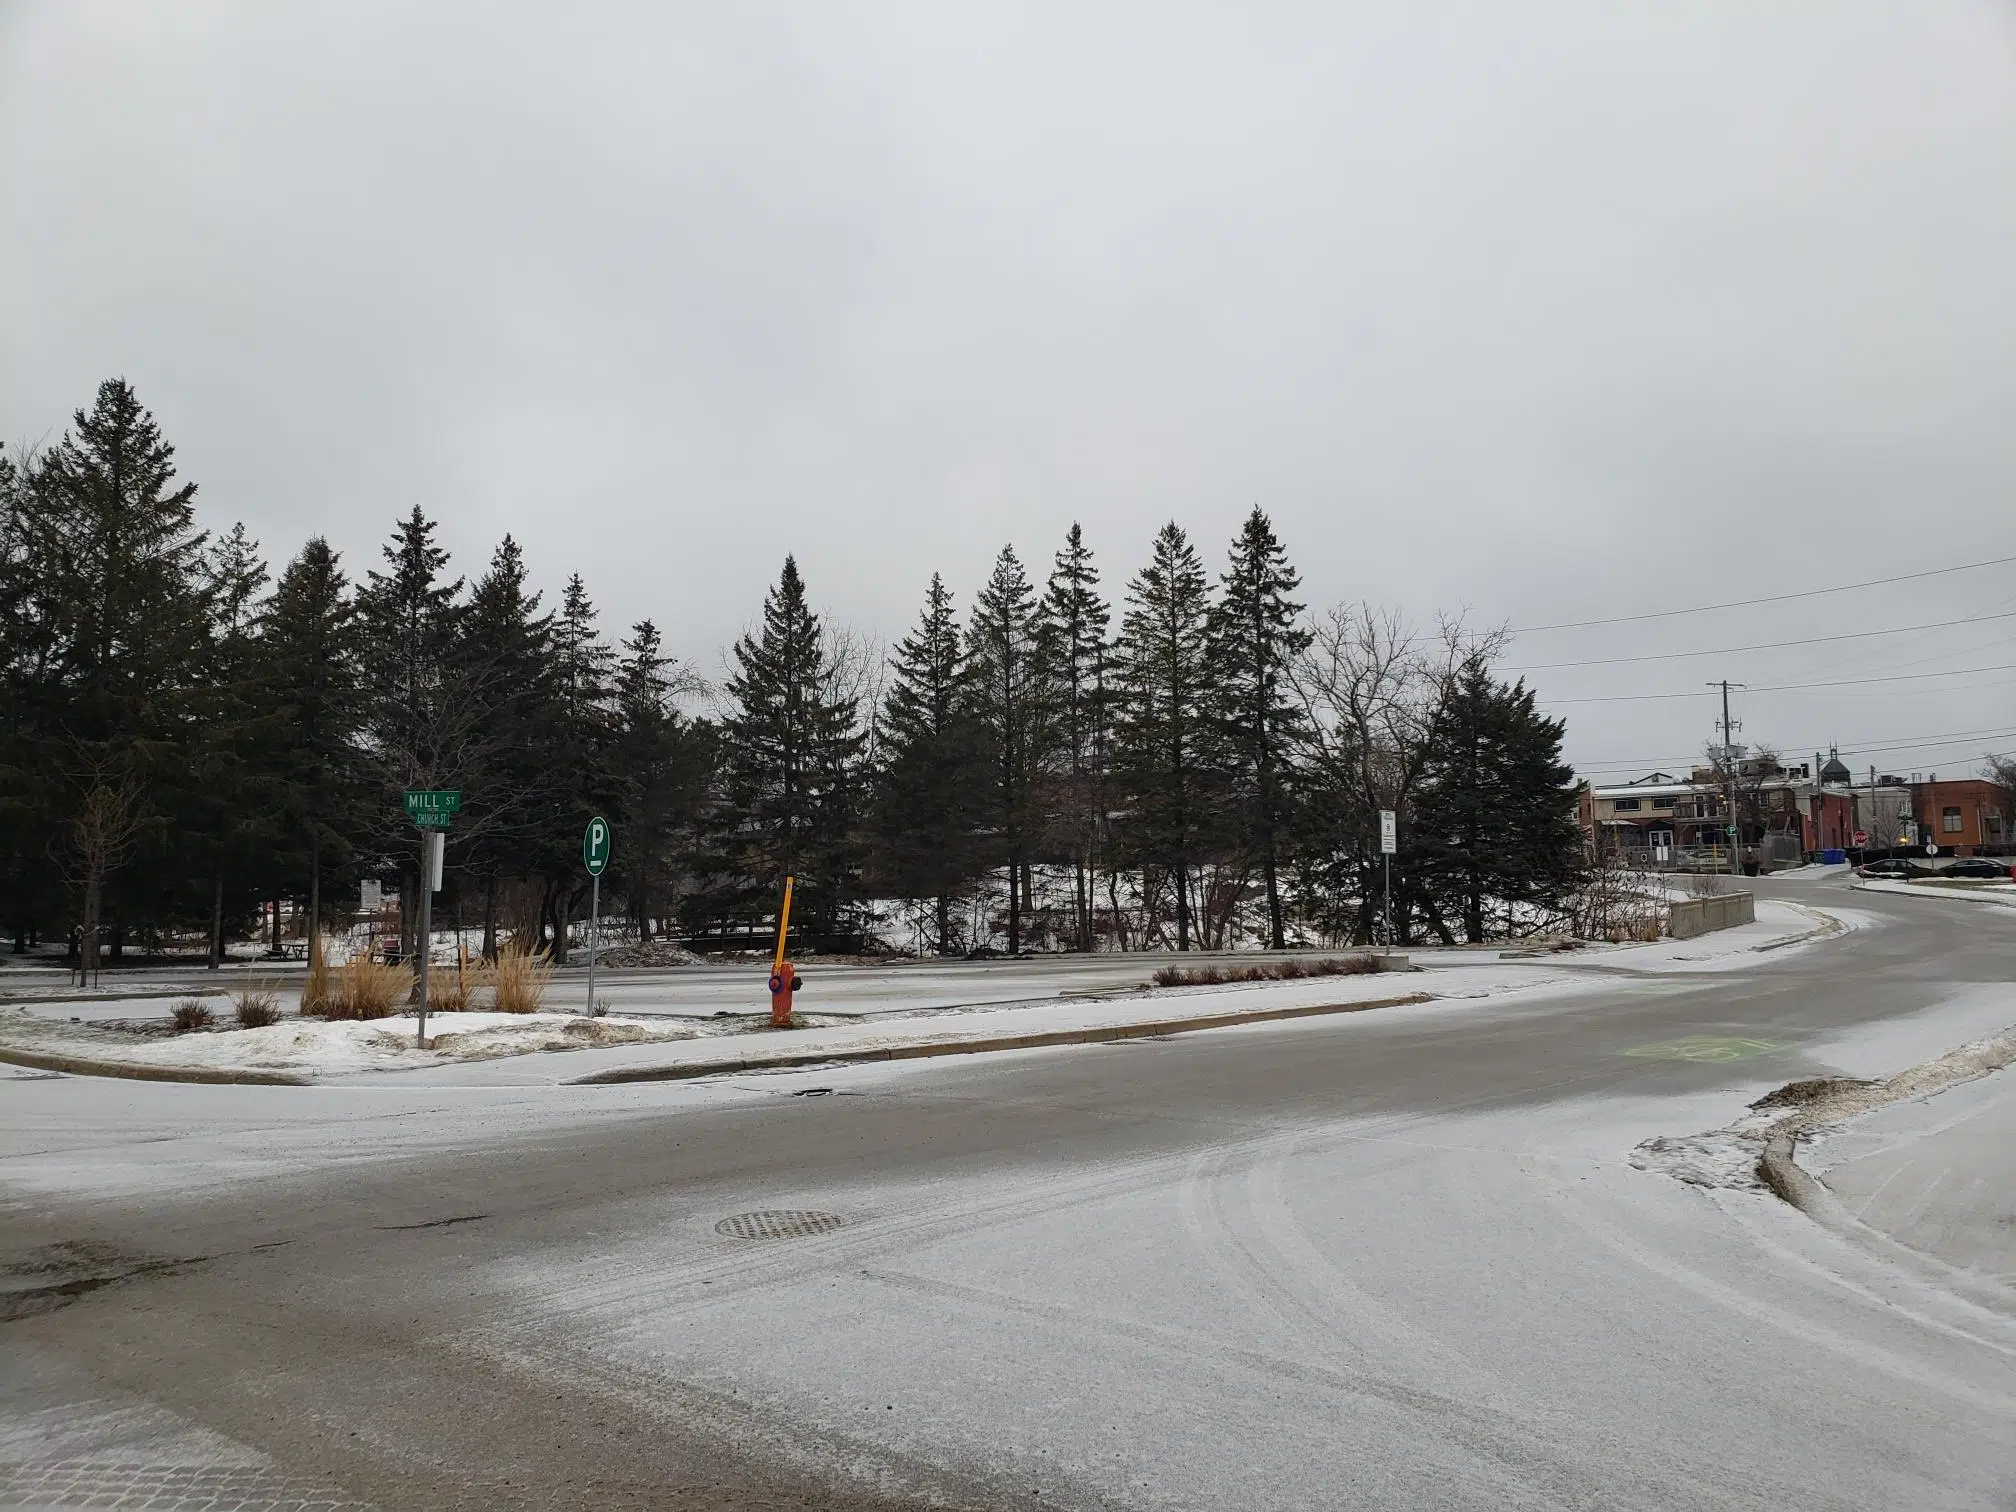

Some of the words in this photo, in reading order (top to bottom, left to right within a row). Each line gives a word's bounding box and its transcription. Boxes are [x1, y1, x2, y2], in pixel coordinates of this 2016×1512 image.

[409, 794, 439, 808] MILL
[445, 797, 455, 805] ST
[417, 813, 438, 825] CHURCH
[440, 813, 446, 825] ST
[592, 824, 604, 857] P
